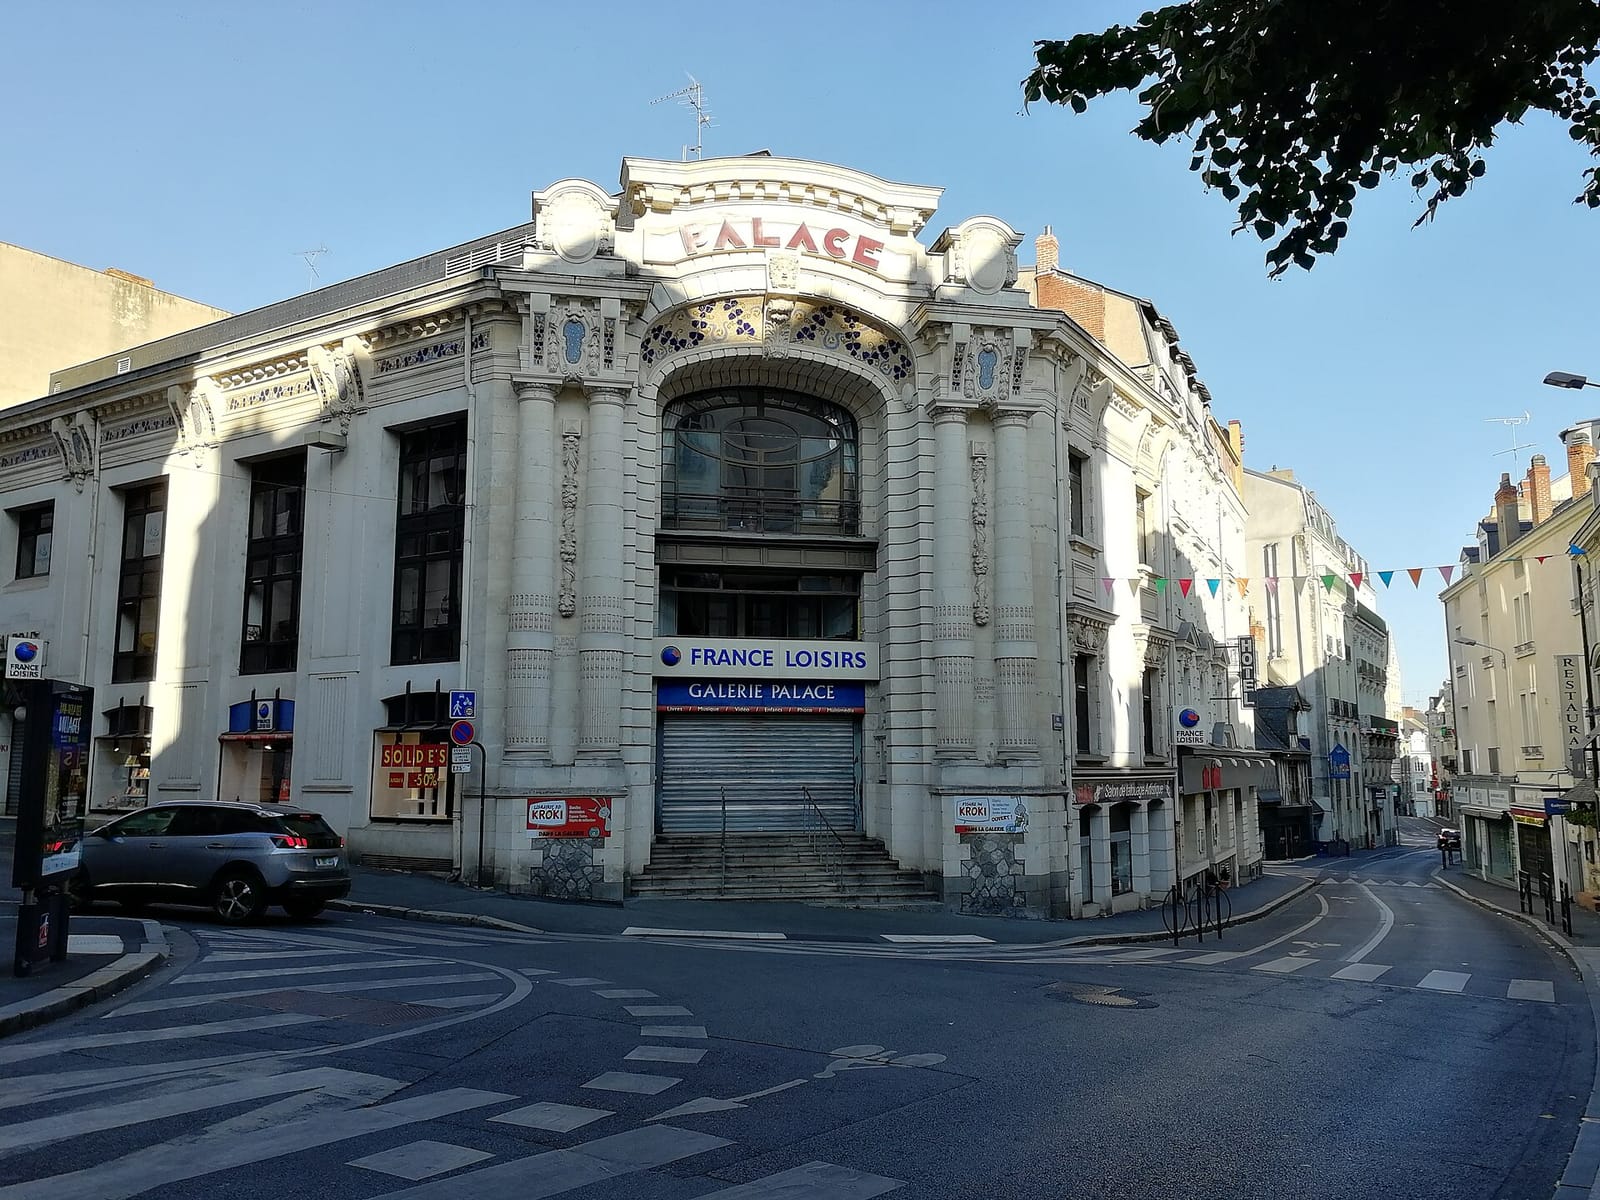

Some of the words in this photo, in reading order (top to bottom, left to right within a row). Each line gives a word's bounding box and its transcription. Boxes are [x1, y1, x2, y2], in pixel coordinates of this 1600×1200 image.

[679, 217, 885, 271] PALACE
[691, 648, 774, 667] FRANCE
[785, 650, 867, 669] LOISIRS
[9, 670, 39, 678] LOISIRS
[10, 663, 39, 671] FRANCE
[1240, 638, 1255, 706] HOTEL
[688, 683, 763, 699] GALERIE
[771, 685, 836, 700] PALACE
[1176, 736, 1204, 744] LOISIRS
[413, 773, 438, 787] -50%
[1104, 783, 1119, 798] Salon
[1126, 783, 1144, 799] tatouage
[532, 809, 563, 820] KROKI
[959, 807, 987, 817] KROKI
